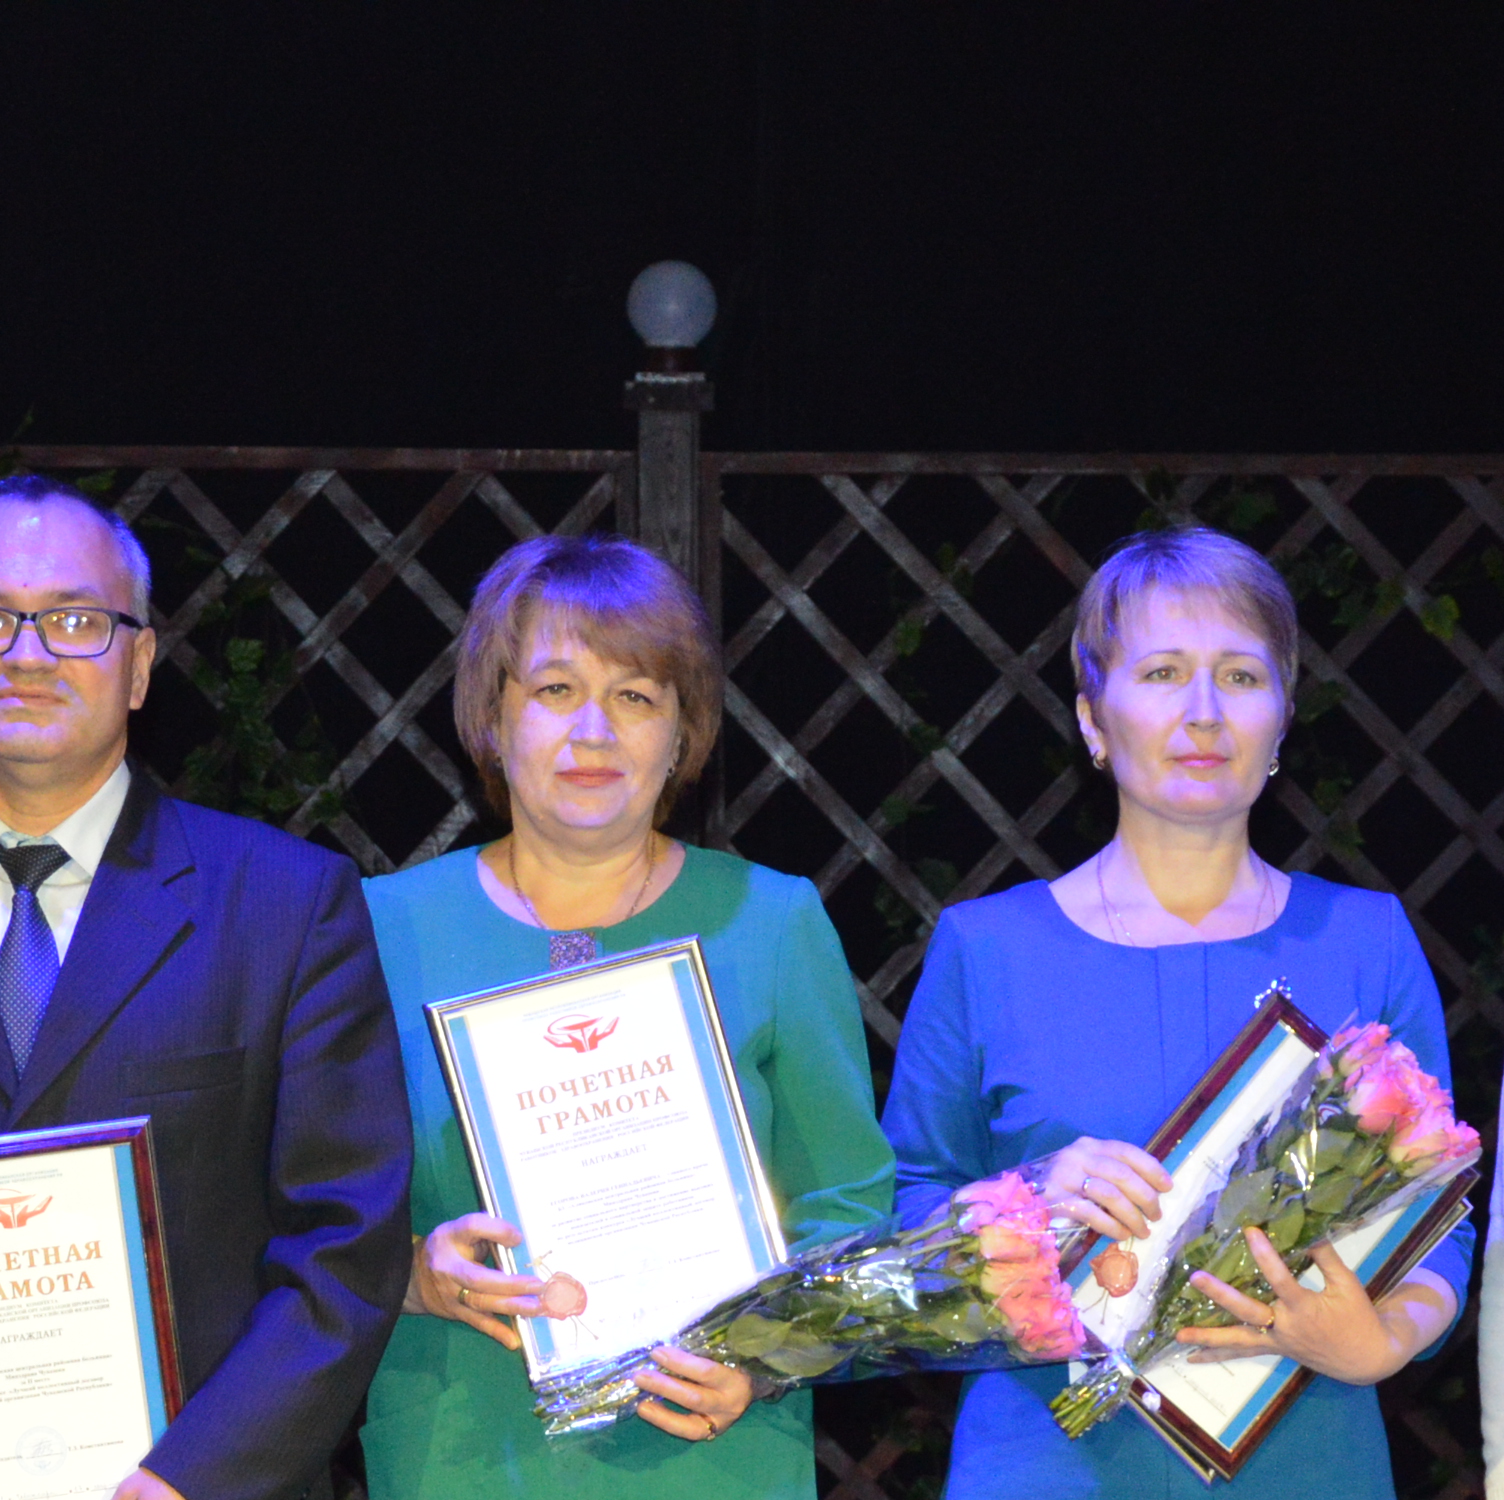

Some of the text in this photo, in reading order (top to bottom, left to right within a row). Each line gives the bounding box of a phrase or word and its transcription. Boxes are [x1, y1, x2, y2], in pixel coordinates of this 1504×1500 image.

[516, 1053, 676, 1111] ПОЧЕТНАЯ
[535, 1084, 672, 1135] ГРАМОТА
[580, 1143, 648, 1167] НАГРАЖДАЕТ
